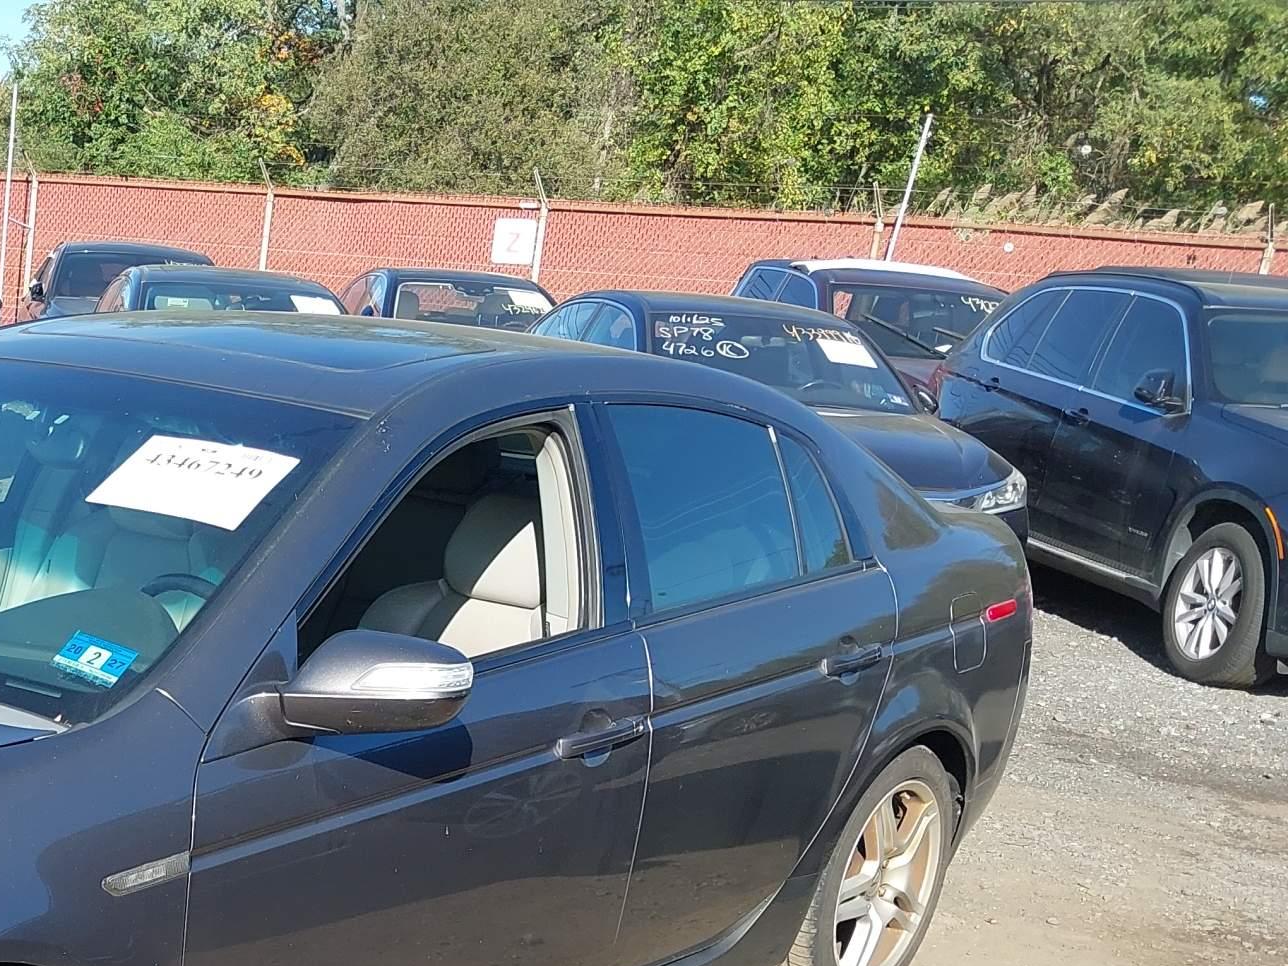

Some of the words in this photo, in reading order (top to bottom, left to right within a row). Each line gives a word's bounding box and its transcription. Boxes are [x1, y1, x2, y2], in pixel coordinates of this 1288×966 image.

[658, 326, 715, 341] SP78
[662, 341, 715, 357] 4726
[145, 453, 263, 480] 43467249
[66, 643, 83, 655] 20
[87, 651, 102, 665] 2
[108, 659, 126, 670] 27
